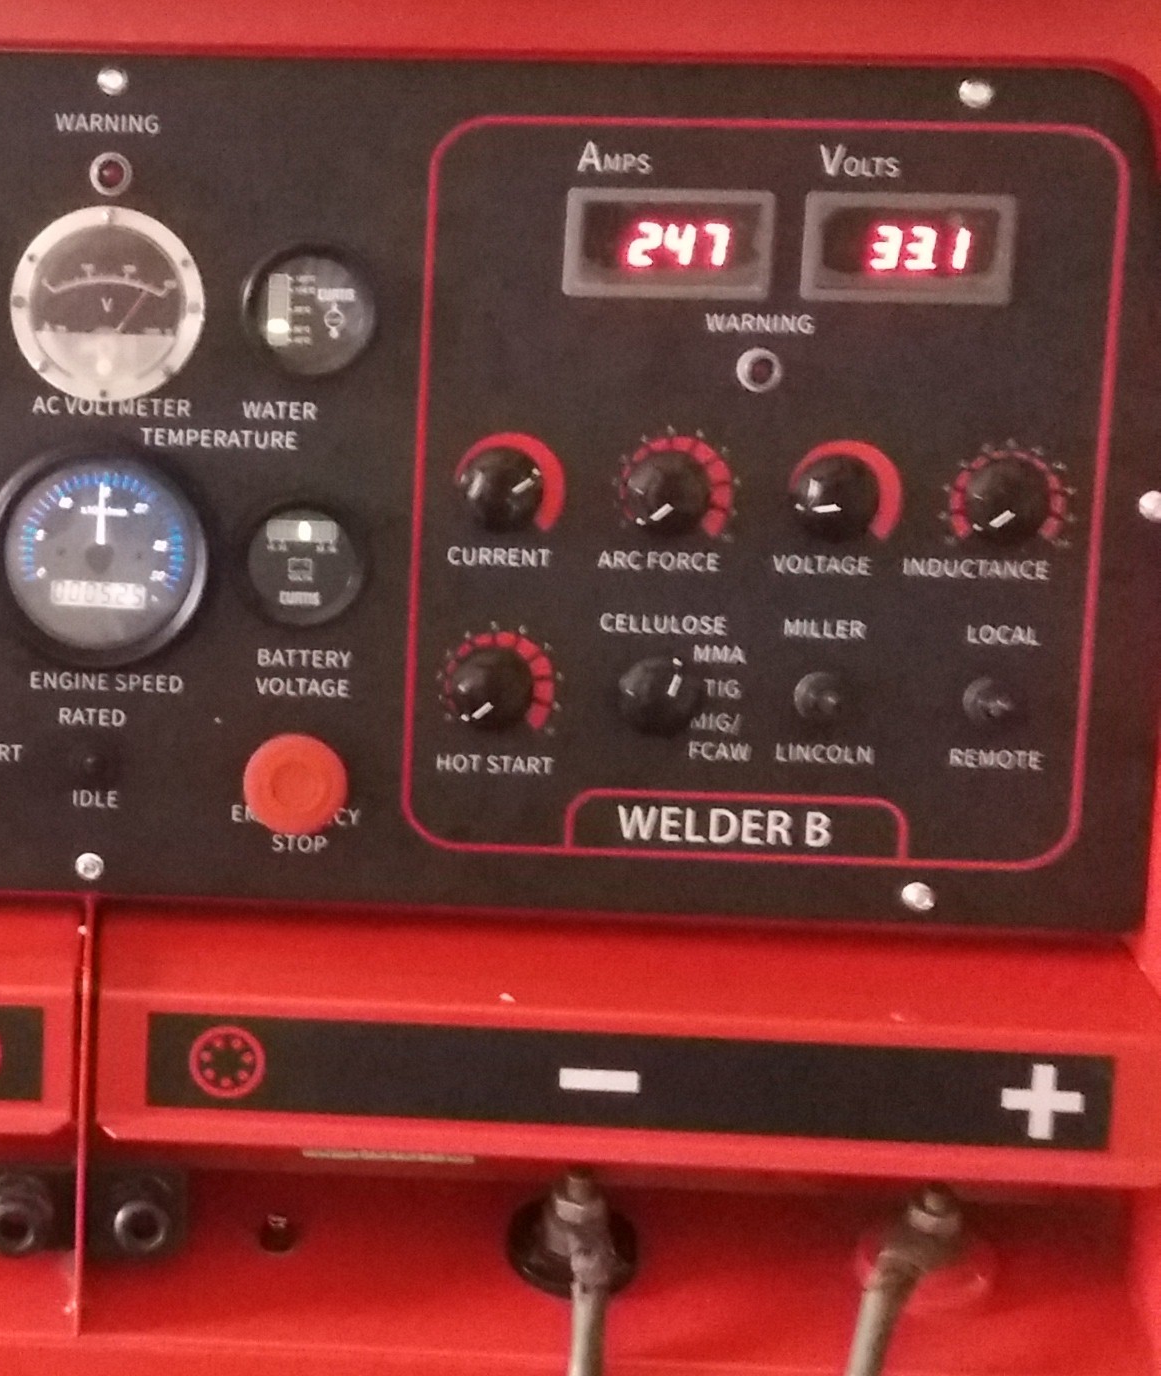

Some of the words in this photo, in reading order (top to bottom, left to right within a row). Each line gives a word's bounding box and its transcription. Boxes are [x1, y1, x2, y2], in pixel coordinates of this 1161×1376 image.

[55, 113, 160, 135] WARNING
[627, 221, 731, 267] 247
[100, 297, 113, 313] V
[705, 313, 815, 335] WARNING
[31, 395, 64, 416] AC
[65, 395, 191, 418] VOLTMETER
[242, 400, 317, 421] WATER
[140, 427, 297, 450] TEMPERATURE
[447, 545, 551, 567] CURRENT
[597, 550, 641, 571] ARC
[646, 551, 719, 573] FORCE
[772, 554, 871, 576] VOLTAGE
[902, 557, 1049, 581] INDUCTANCE
[599, 612, 727, 636] CELLULOSE
[783, 618, 867, 640] MILLER
[966, 624, 1039, 646] LOCAL
[257, 648, 351, 669] BATTERY
[693, 644, 746, 664] MMA
[29, 670, 109, 691] ENGINE
[115, 674, 184, 694] SPEED
[255, 677, 349, 698] VOLTAGE
[704, 678, 742, 699] TIG
[58, 707, 127, 727] RATED
[688, 740, 750, 762] FCAW
[775, 743, 874, 765] LINCOLN
[949, 747, 1042, 771] REMOTE
[436, 753, 482, 773] HOT
[486, 754, 553, 774] START
[72, 789, 118, 809] IDLE
[616, 803, 793, 847] WELDER
[804, 811, 831, 847] B
[271, 833, 328, 854] STOP
